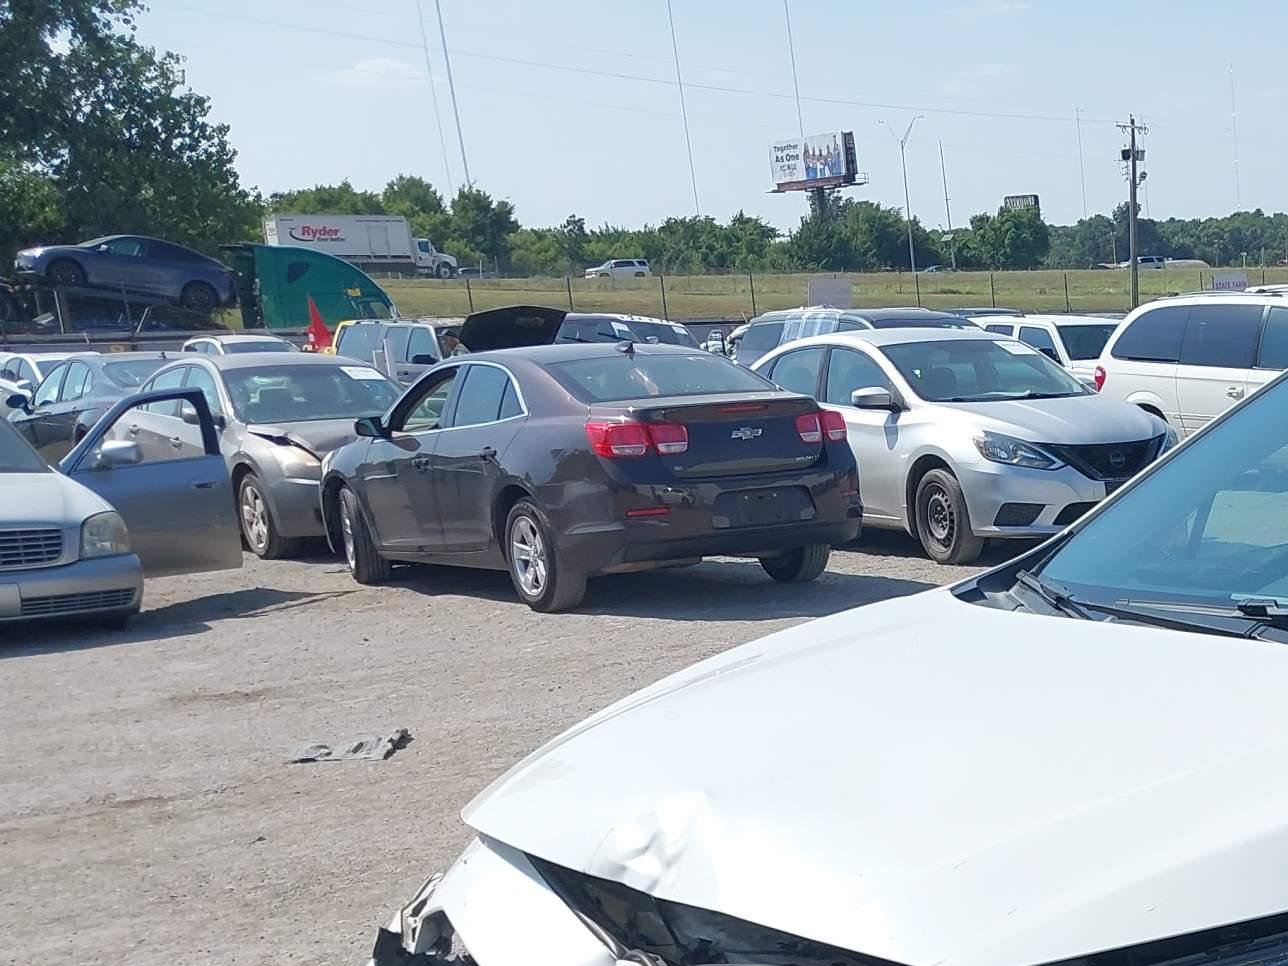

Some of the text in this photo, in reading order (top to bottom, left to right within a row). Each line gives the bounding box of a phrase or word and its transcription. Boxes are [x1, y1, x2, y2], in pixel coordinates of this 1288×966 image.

[773, 143, 799, 154] Together
[775, 153, 800, 163] As One
[301, 225, 340, 238] Ryder
